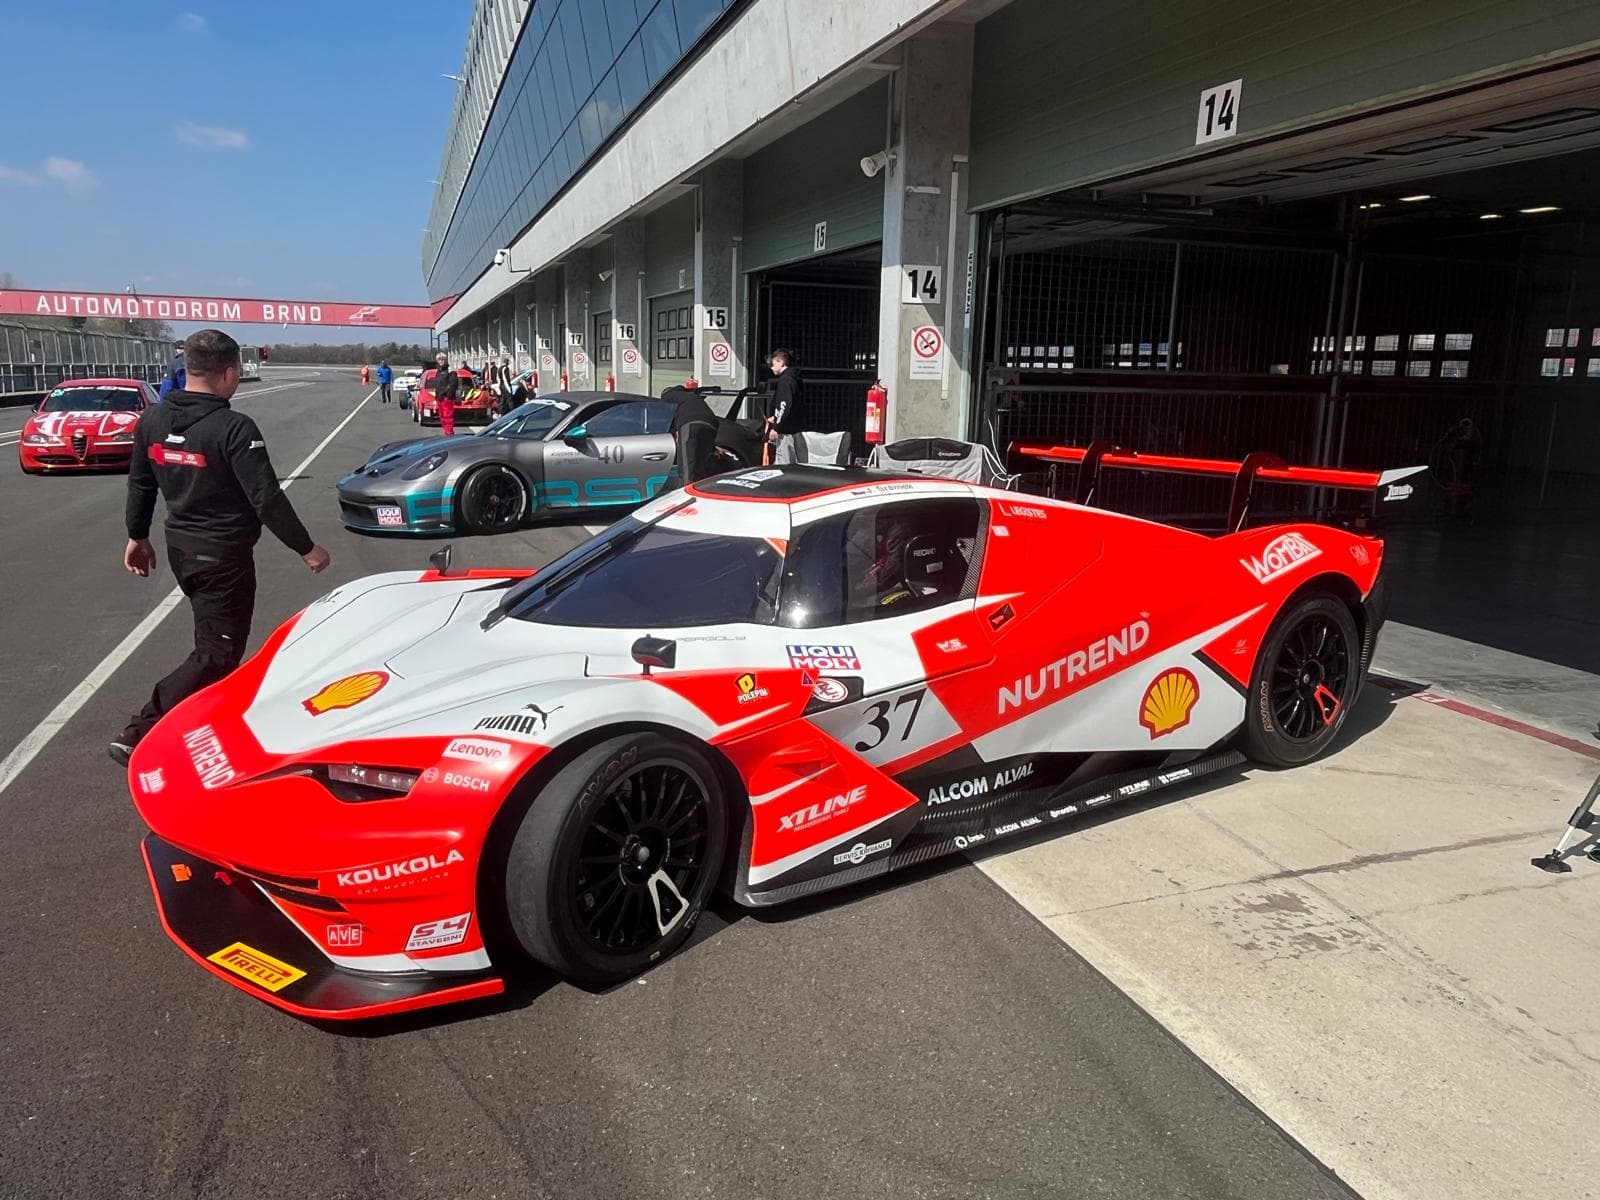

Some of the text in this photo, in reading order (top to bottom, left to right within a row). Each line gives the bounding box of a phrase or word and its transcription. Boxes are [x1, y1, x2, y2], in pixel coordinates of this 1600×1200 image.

[1205, 88, 1234, 136] 14
[816, 224, 825, 249] 15
[907, 269, 937, 299] 14
[36, 295, 322, 322] AUTOMOTODROM BRNO
[706, 309, 726, 328] 15
[570, 334, 582, 345] 17
[619, 325, 634, 339] 16
[599, 445, 624, 464] 40
[788, 646, 854, 657] LIQUI
[792, 657, 857, 669] MOLY
[998, 620, 1150, 714] NUTREND
[472, 714, 537, 735] PUMA
[855, 688, 927, 752] 37
[182, 723, 236, 790] NUTREND
[450, 742, 502, 759] Lenovo
[443, 772, 491, 792] BOSCH
[927, 762, 1034, 806] ALCOM ALVAL
[776, 784, 866, 832] XTLINE
[336, 849, 465, 887] KOUKOLA
[328, 928, 360, 942] AVE
[220, 948, 292, 984] PIRELLI
